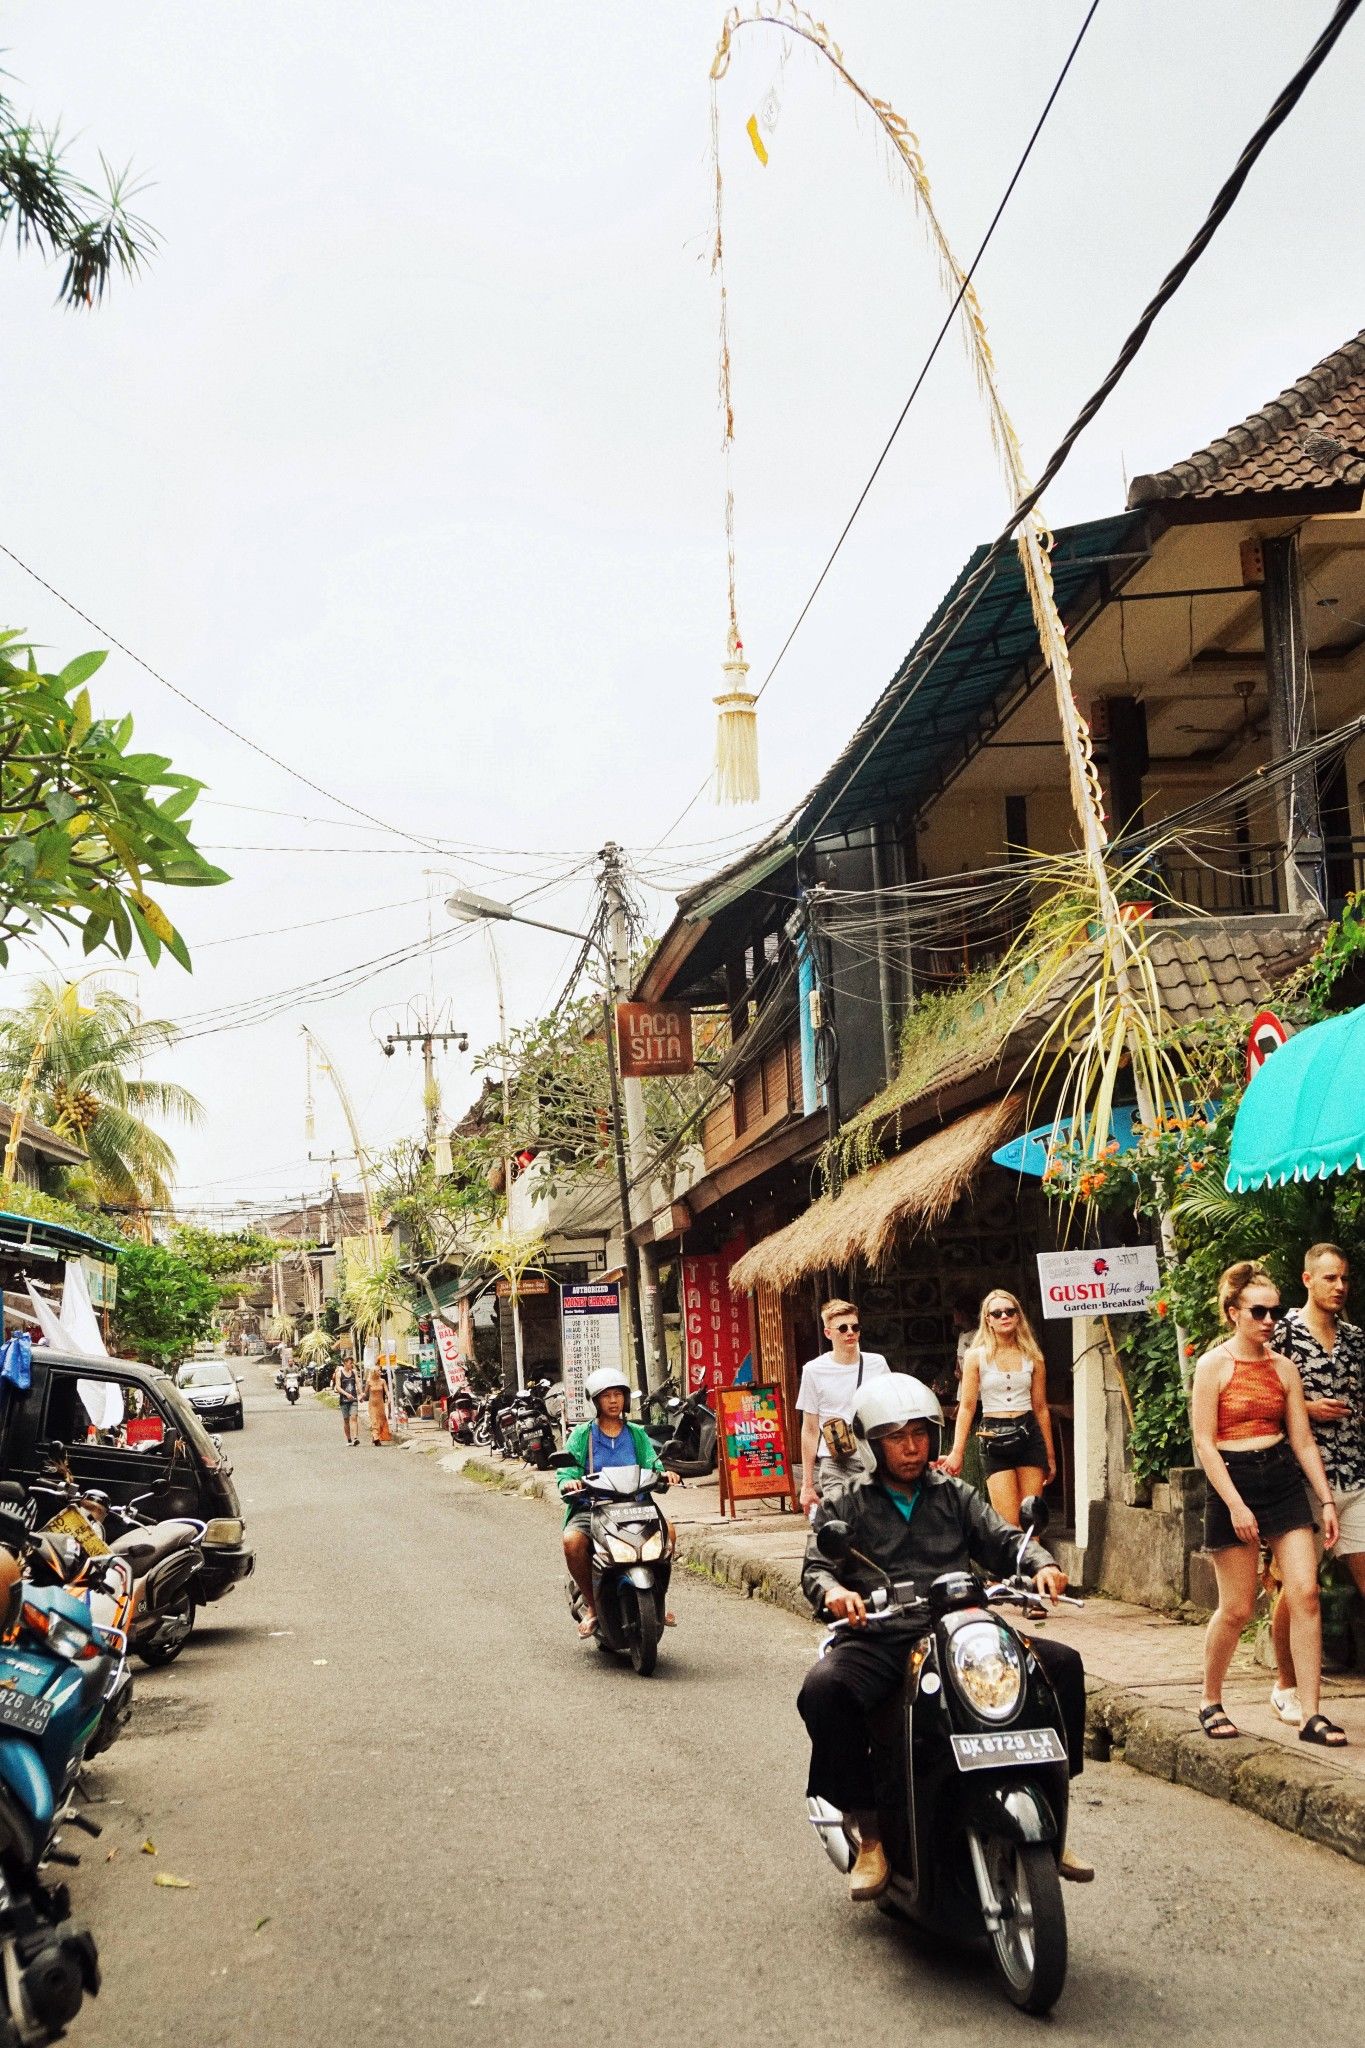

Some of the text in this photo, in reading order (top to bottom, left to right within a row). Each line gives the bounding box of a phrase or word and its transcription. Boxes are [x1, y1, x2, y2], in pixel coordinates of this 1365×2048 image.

[630, 1013, 680, 1036] LACA
[631, 1036, 681, 1060] SITA
[572, 1285, 609, 1294] AUTHORIZED
[1049, 1280, 1155, 1302] GUSTI Home Stay
[564, 1295, 618, 1308] MONEY CHANGER
[687, 1262, 703, 1385] TACOS
[709, 1262, 723, 1385] TEQUILA
[734, 1417, 775, 1435] NIÑO
[735, 1432, 776, 1441] WEDNESDAY
